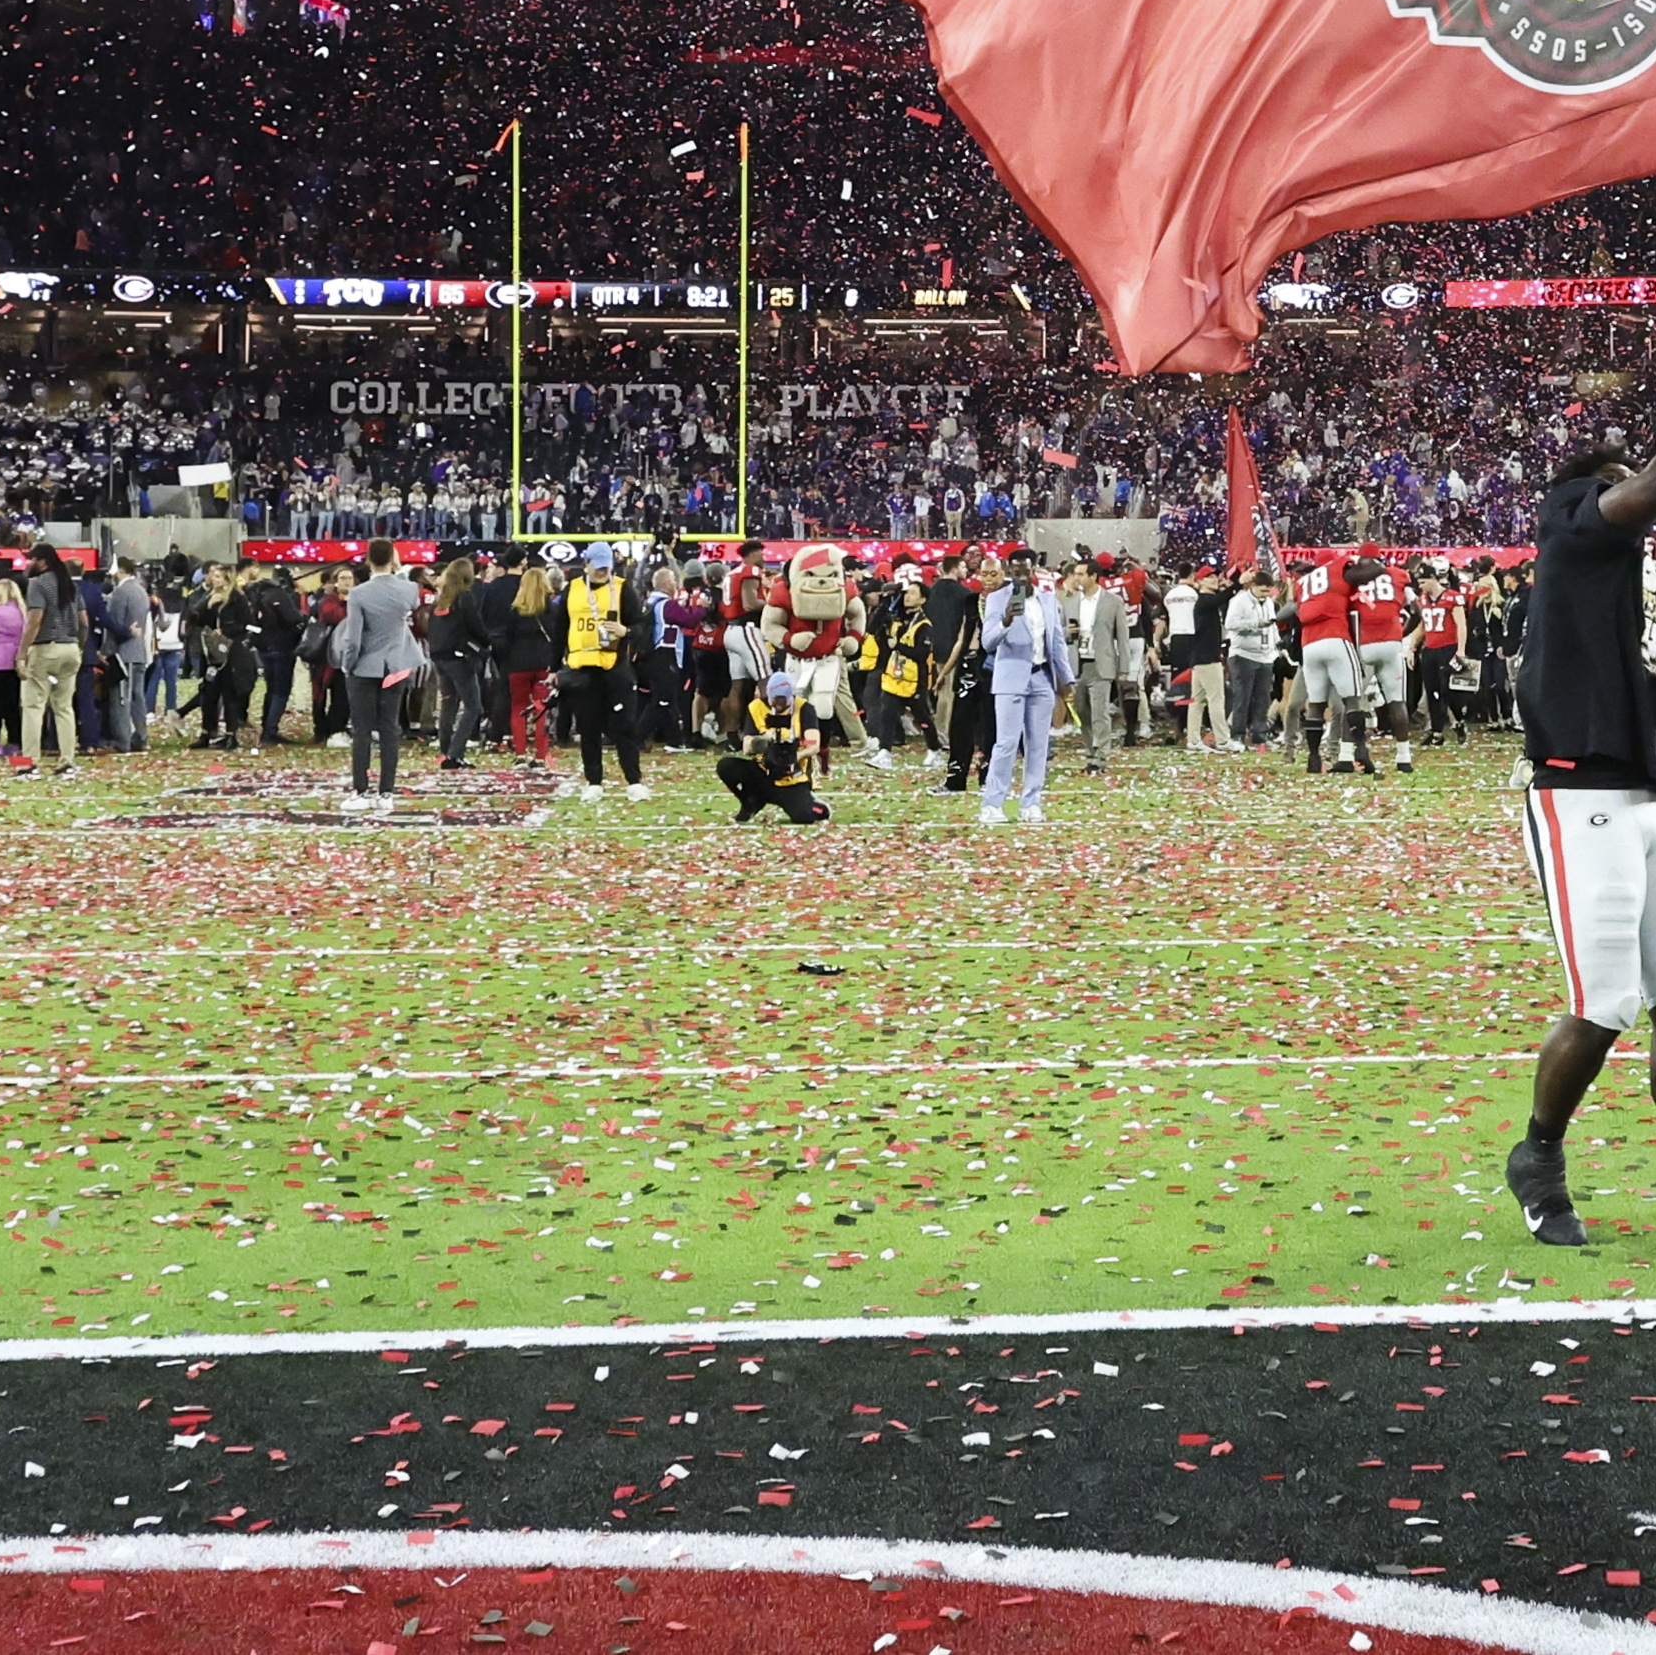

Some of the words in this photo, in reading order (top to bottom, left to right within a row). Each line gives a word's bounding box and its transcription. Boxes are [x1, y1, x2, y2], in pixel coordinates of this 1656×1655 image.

[322, 278, 384, 307] TCU
[407, 283, 420, 304] 7
[438, 283, 466, 306] 65
[592, 286, 624, 306] QTR
[626, 286, 640, 305] 4
[686, 288, 730, 308] 8:21
[769, 287, 794, 308] 25
[913, 289, 945, 307] BALL
[946, 289, 967, 307] ON
[329, 381, 517, 417] COLLE
[1297, 566, 1329, 603] 78
[1421, 607, 1446, 632] 97
